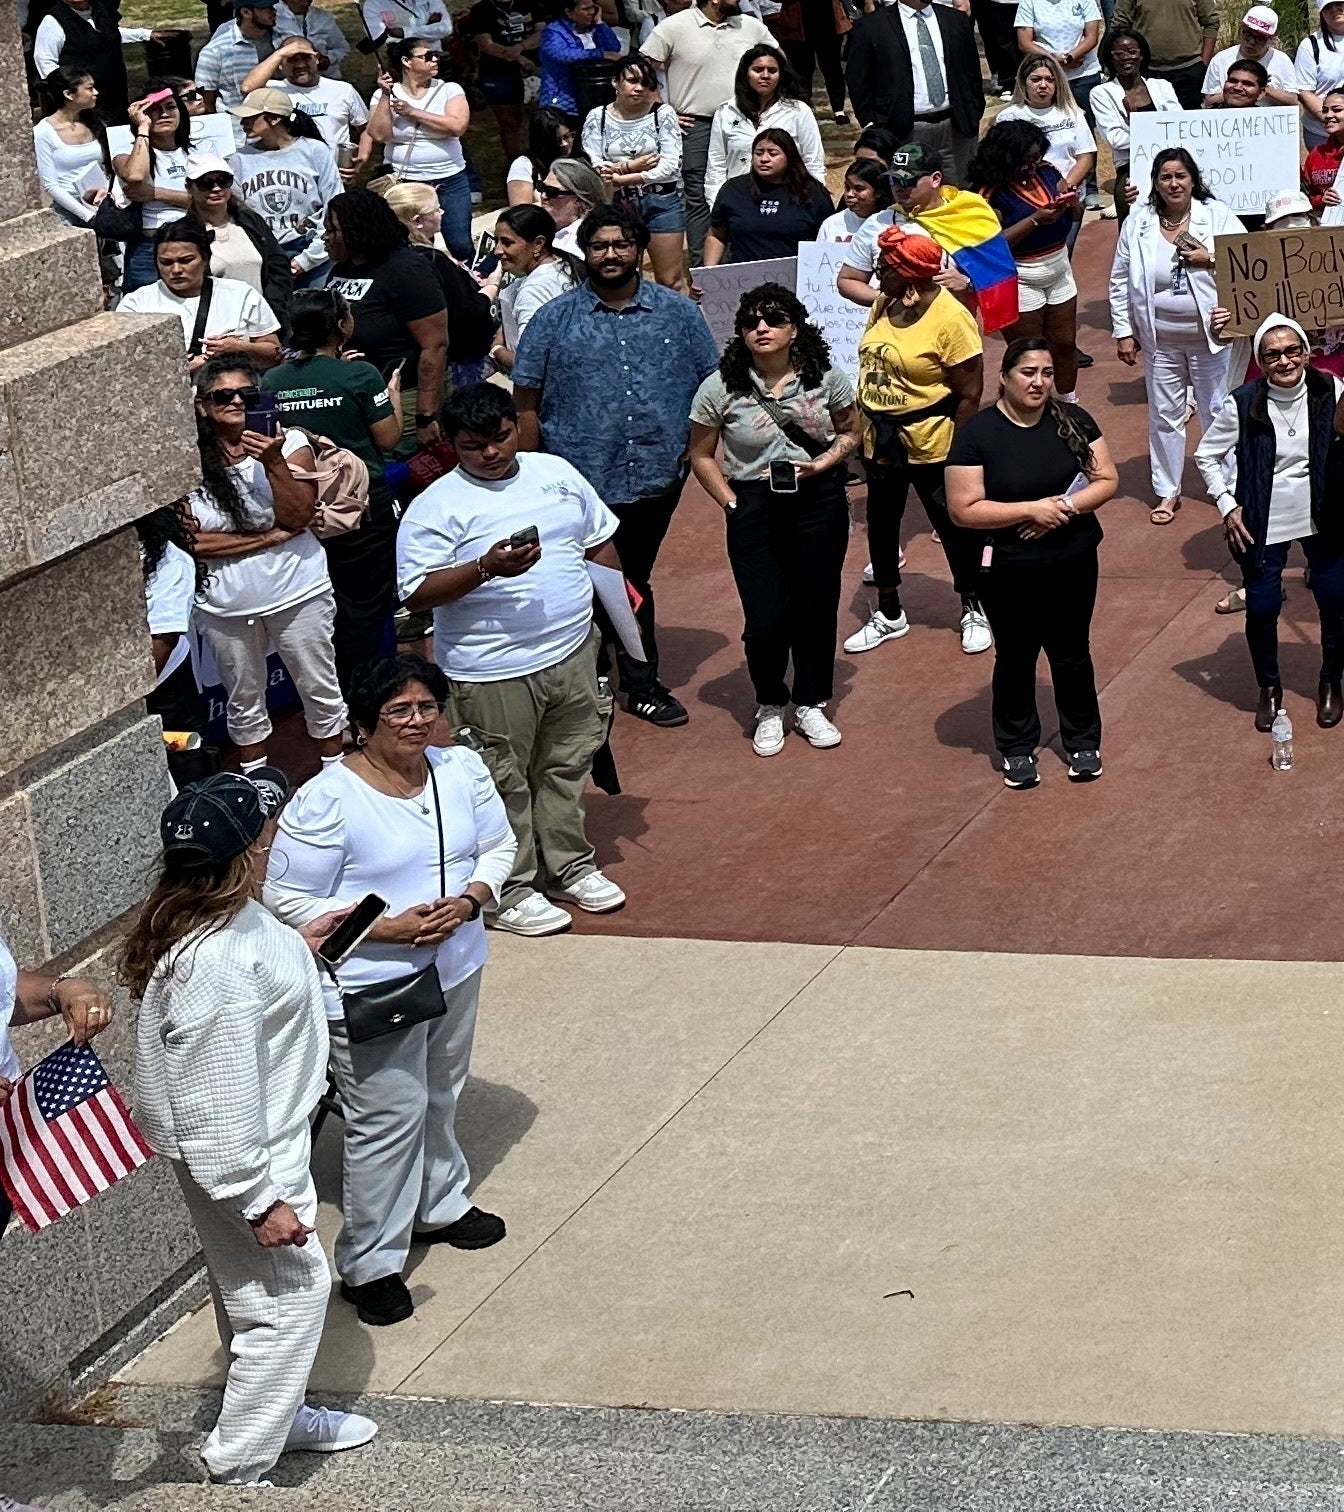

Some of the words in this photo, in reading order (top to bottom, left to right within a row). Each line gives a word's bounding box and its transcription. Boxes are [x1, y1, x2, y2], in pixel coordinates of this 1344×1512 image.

[1156, 114, 1297, 141] TECNICAMENTE
[1217, 142, 1245, 159] ME
[242, 169, 276, 200] PARK
[276, 169, 309, 195] CITY
[1227, 242, 1268, 284] No
[1230, 287, 1260, 326] is
[275, 396, 344, 412] NSTITUENT
